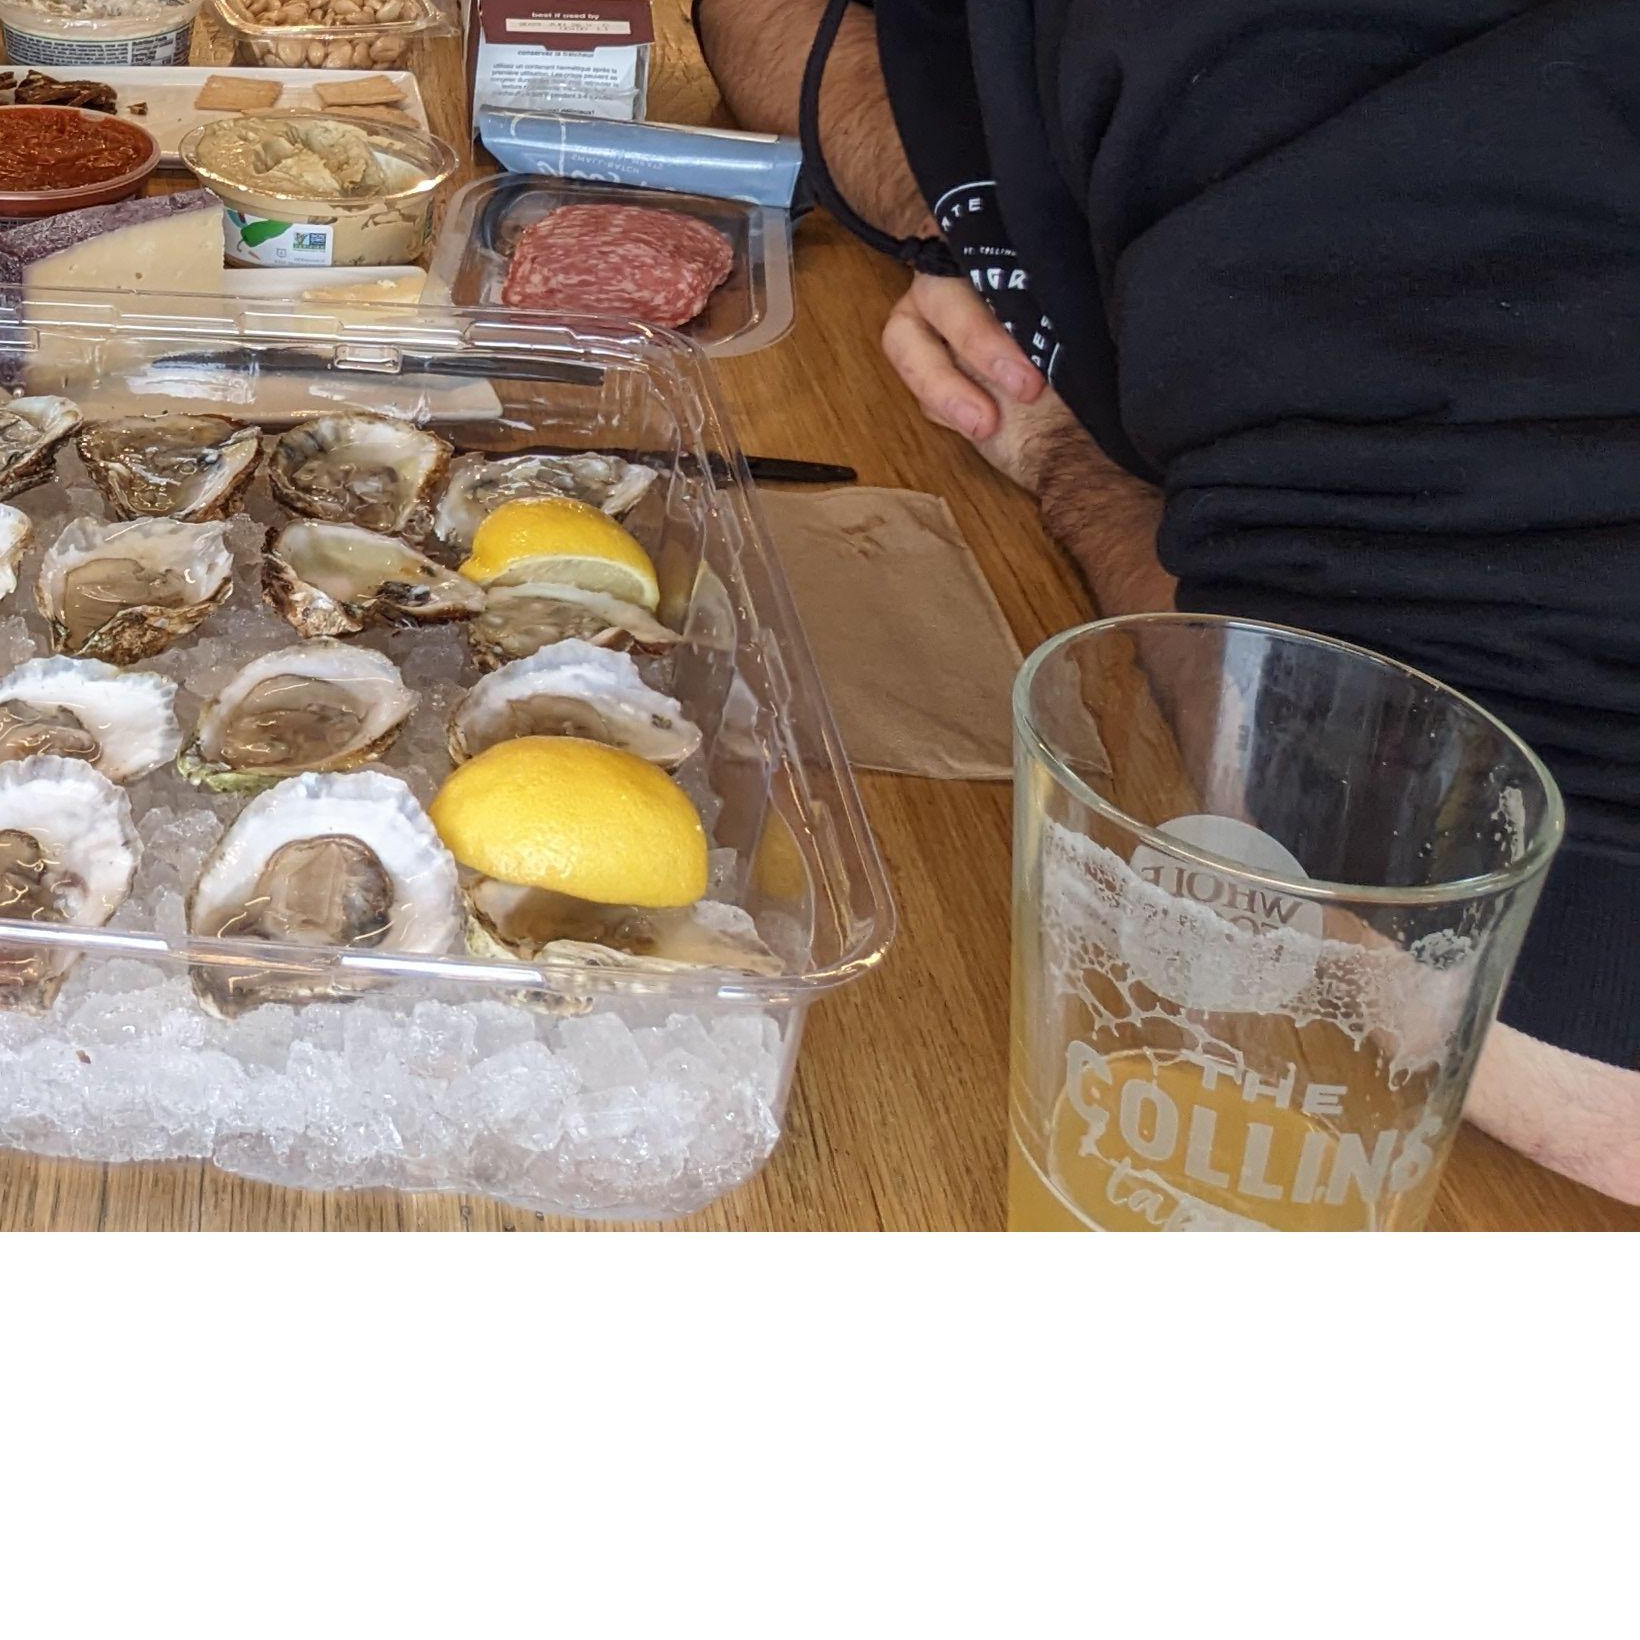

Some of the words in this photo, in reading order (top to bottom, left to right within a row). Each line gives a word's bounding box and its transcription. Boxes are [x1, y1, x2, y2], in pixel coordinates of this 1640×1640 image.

[587, 13, 600, 21] by
[1186, 1060, 1348, 1116] THE
[1065, 1040, 1443, 1207] COLLINS
